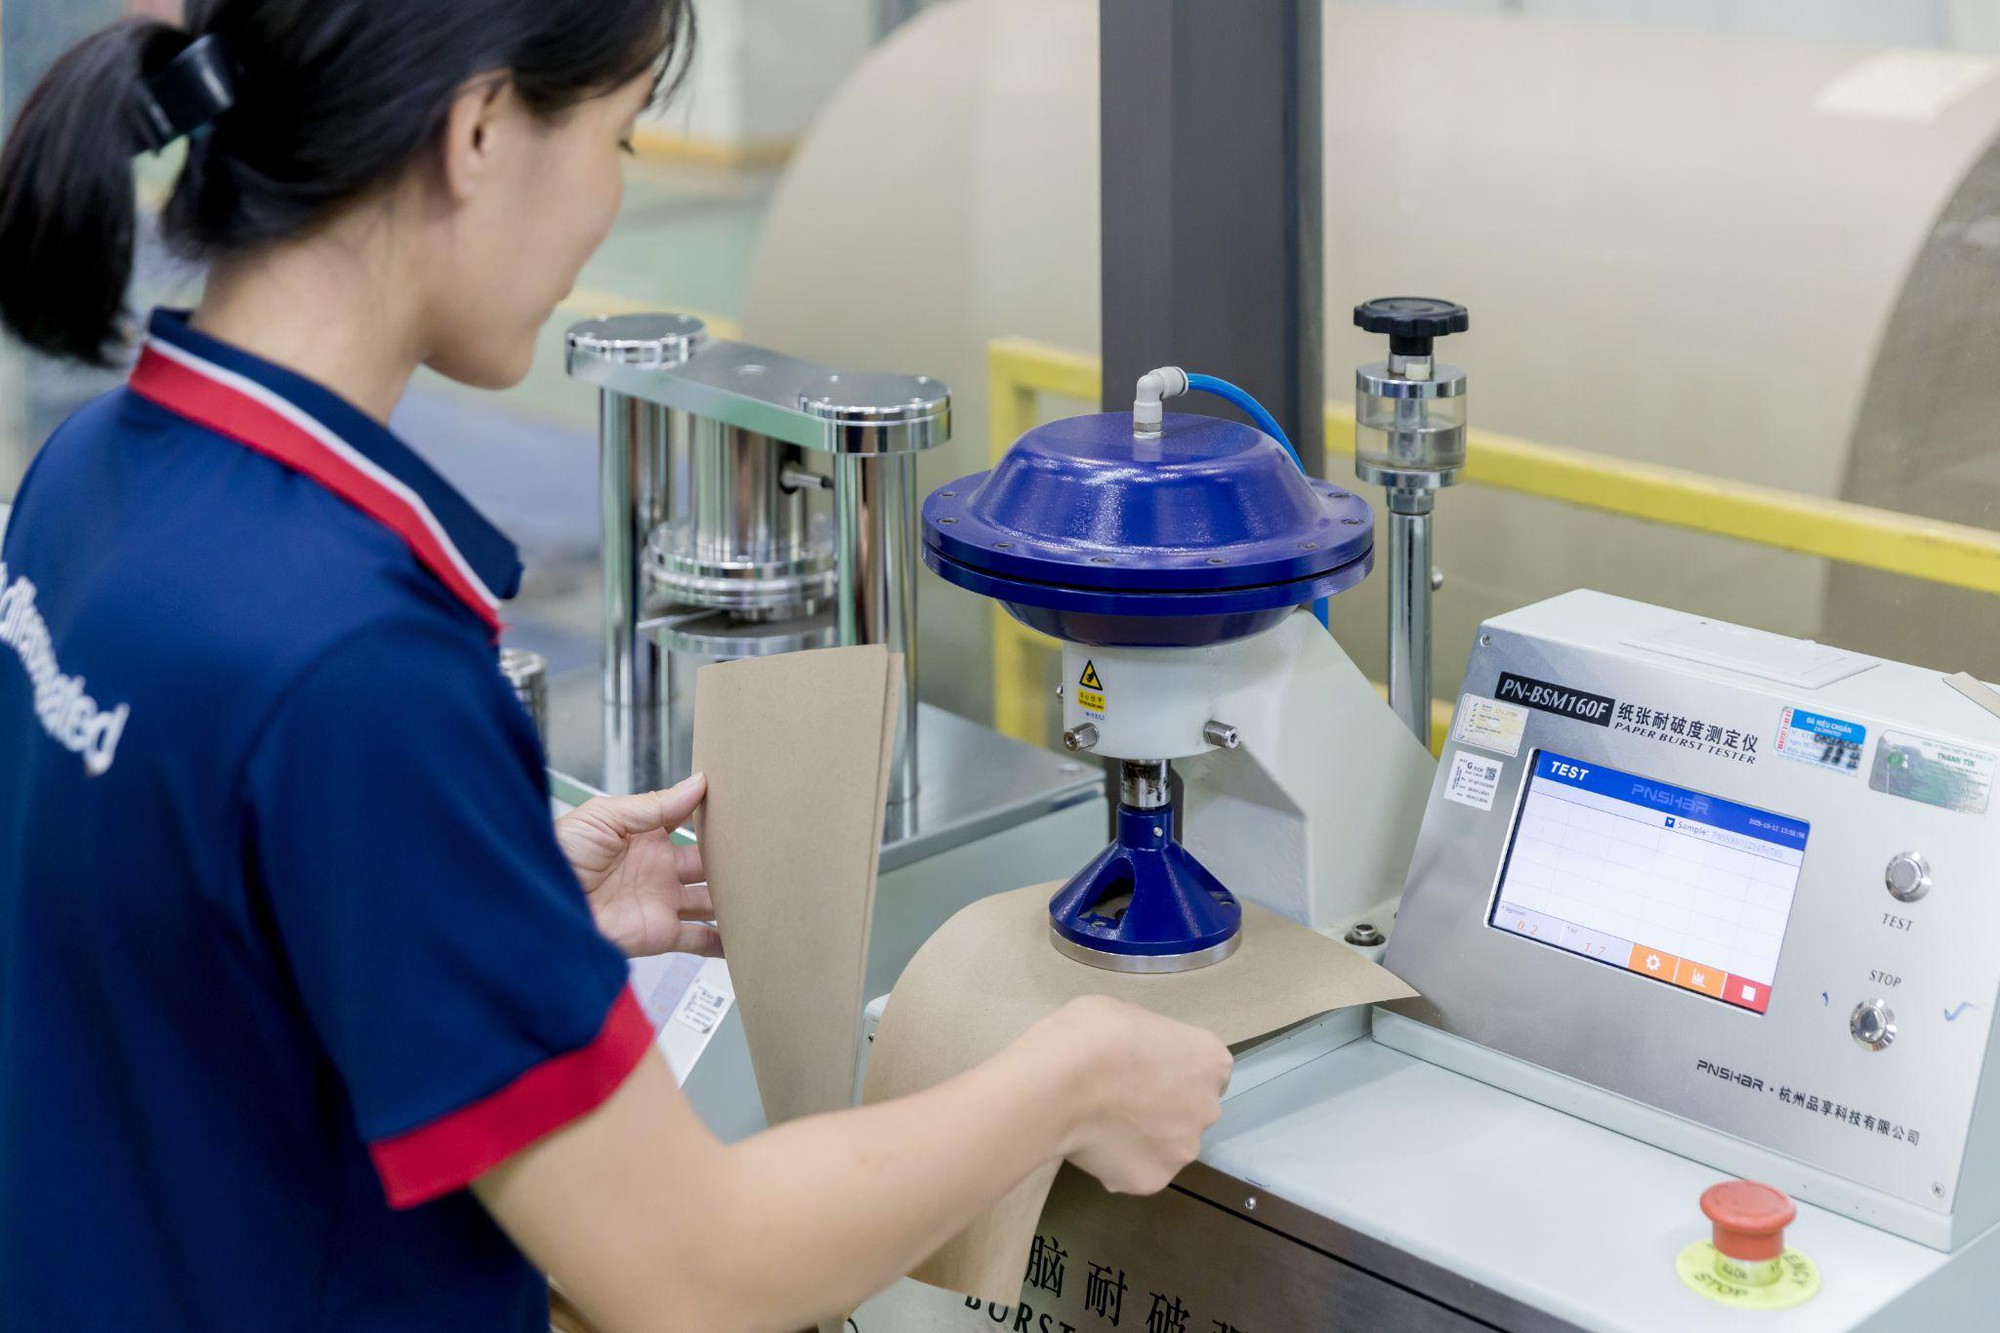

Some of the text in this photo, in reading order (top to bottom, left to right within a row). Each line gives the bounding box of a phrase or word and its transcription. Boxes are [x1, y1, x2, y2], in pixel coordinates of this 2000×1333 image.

[1501, 678, 1609, 719] PN-BSM160F
[1614, 722, 1756, 764] PAPER BURST TESTER
[1617, 702, 1758, 753] 纸张耐破度测定仪
[1550, 761, 1589, 781] TEST
[1882, 913, 1914, 932] TEST
[1868, 969, 1902, 987] STOP
[1778, 1086, 1921, 1147] 杭州品享科技有限公司
